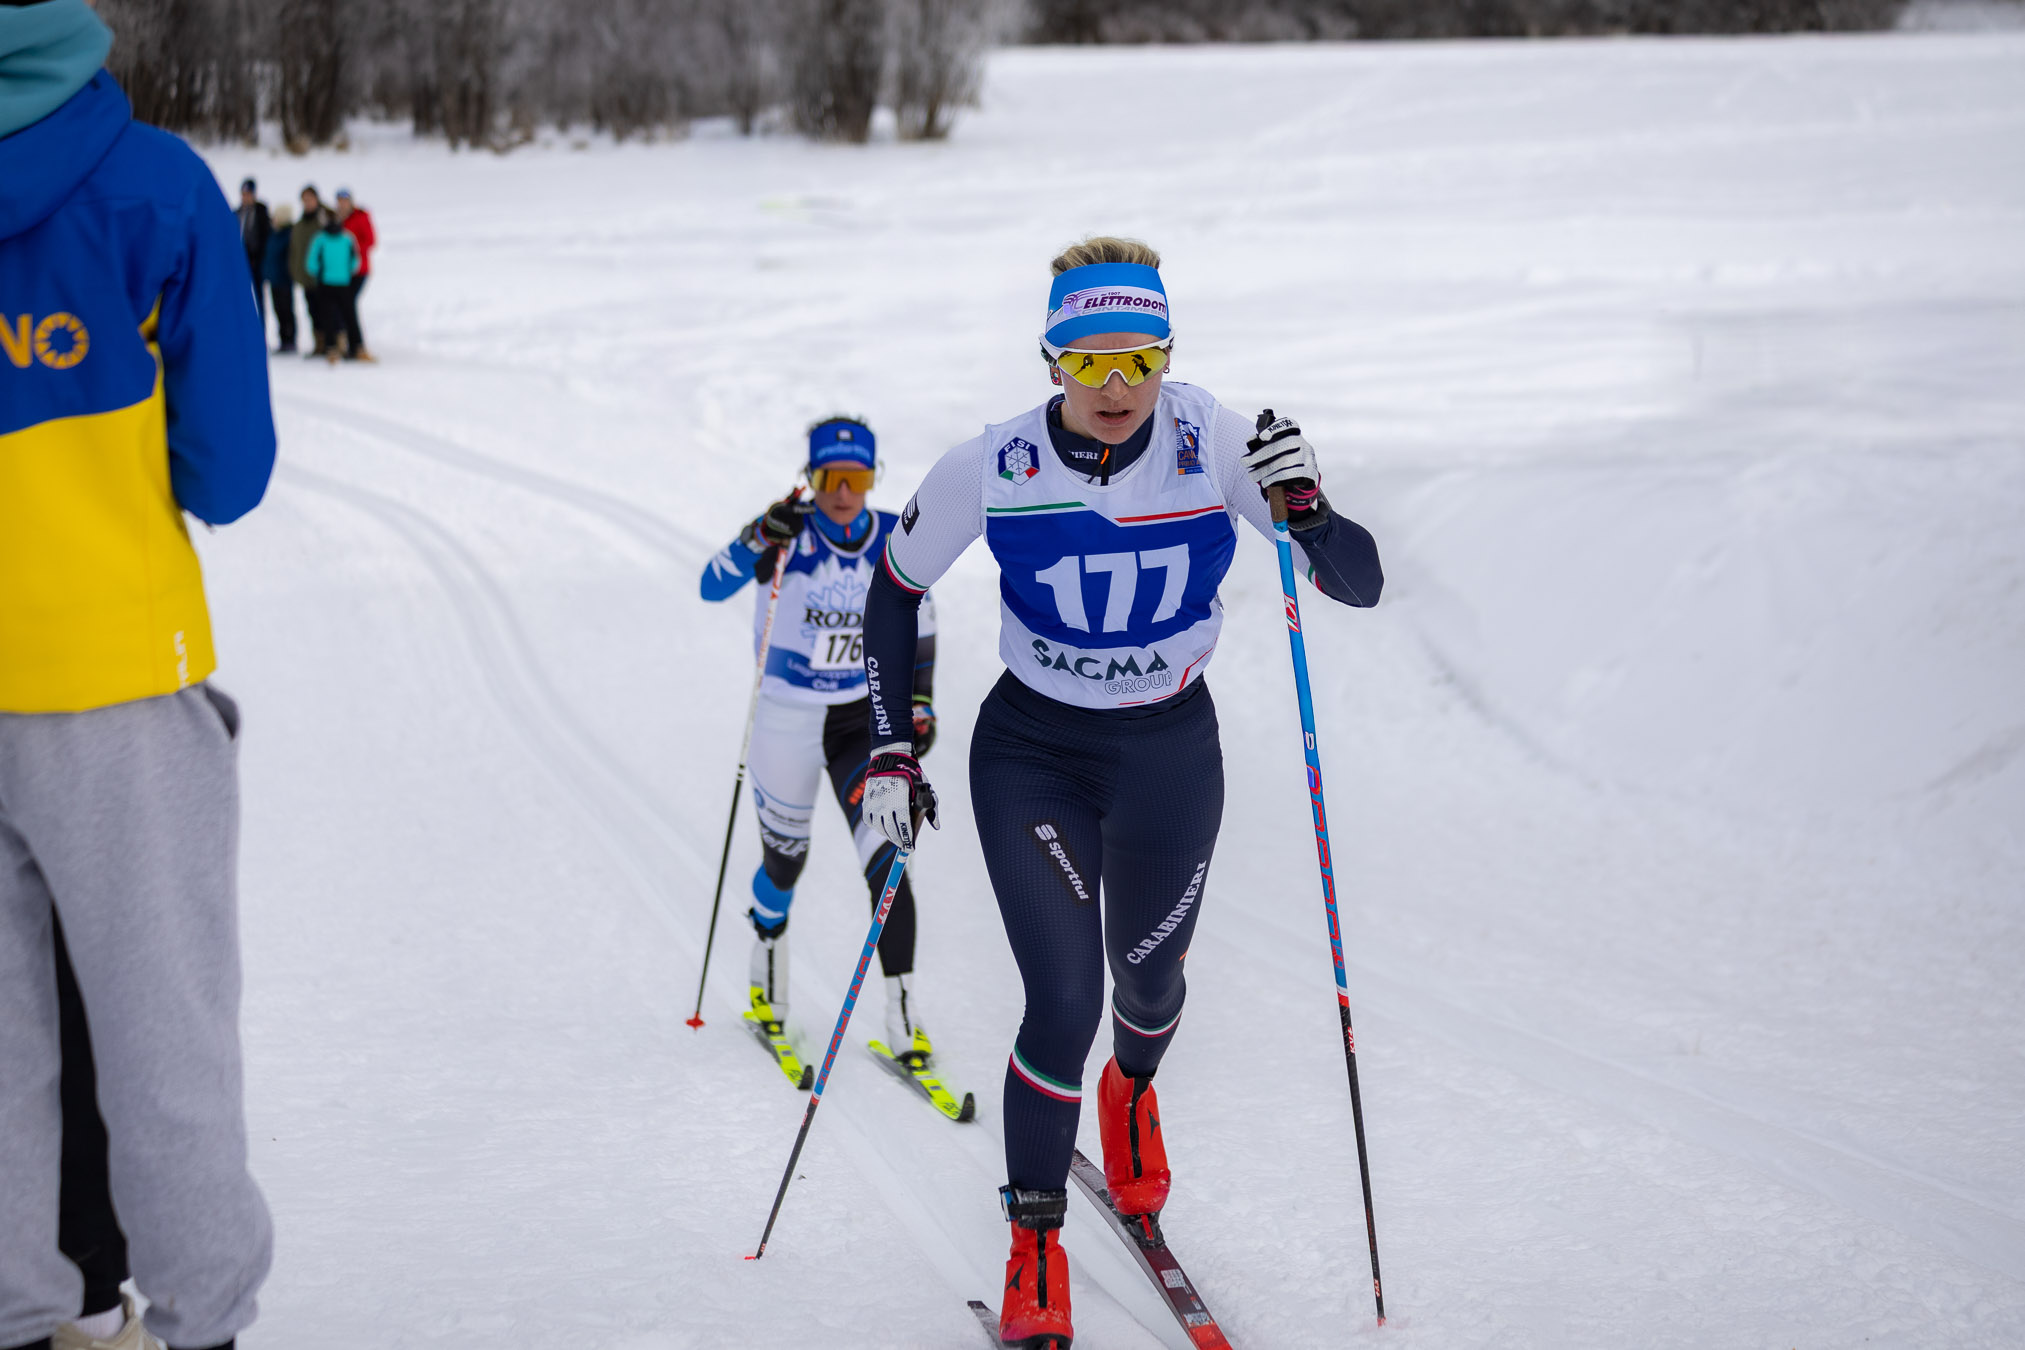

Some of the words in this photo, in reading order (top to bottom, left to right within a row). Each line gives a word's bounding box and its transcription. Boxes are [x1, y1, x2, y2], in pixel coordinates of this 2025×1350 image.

[1003, 439, 1031, 453] FISI
[1035, 543, 1190, 634] 177
[803, 606, 864, 629] ROD
[825, 633, 864, 664] 176
[1031, 638, 1169, 681] SACMA
[1104, 671, 1172, 695] GROUP
[1048, 841, 1090, 900] sportful
[1126, 860, 1207, 965] CARABINIERI
